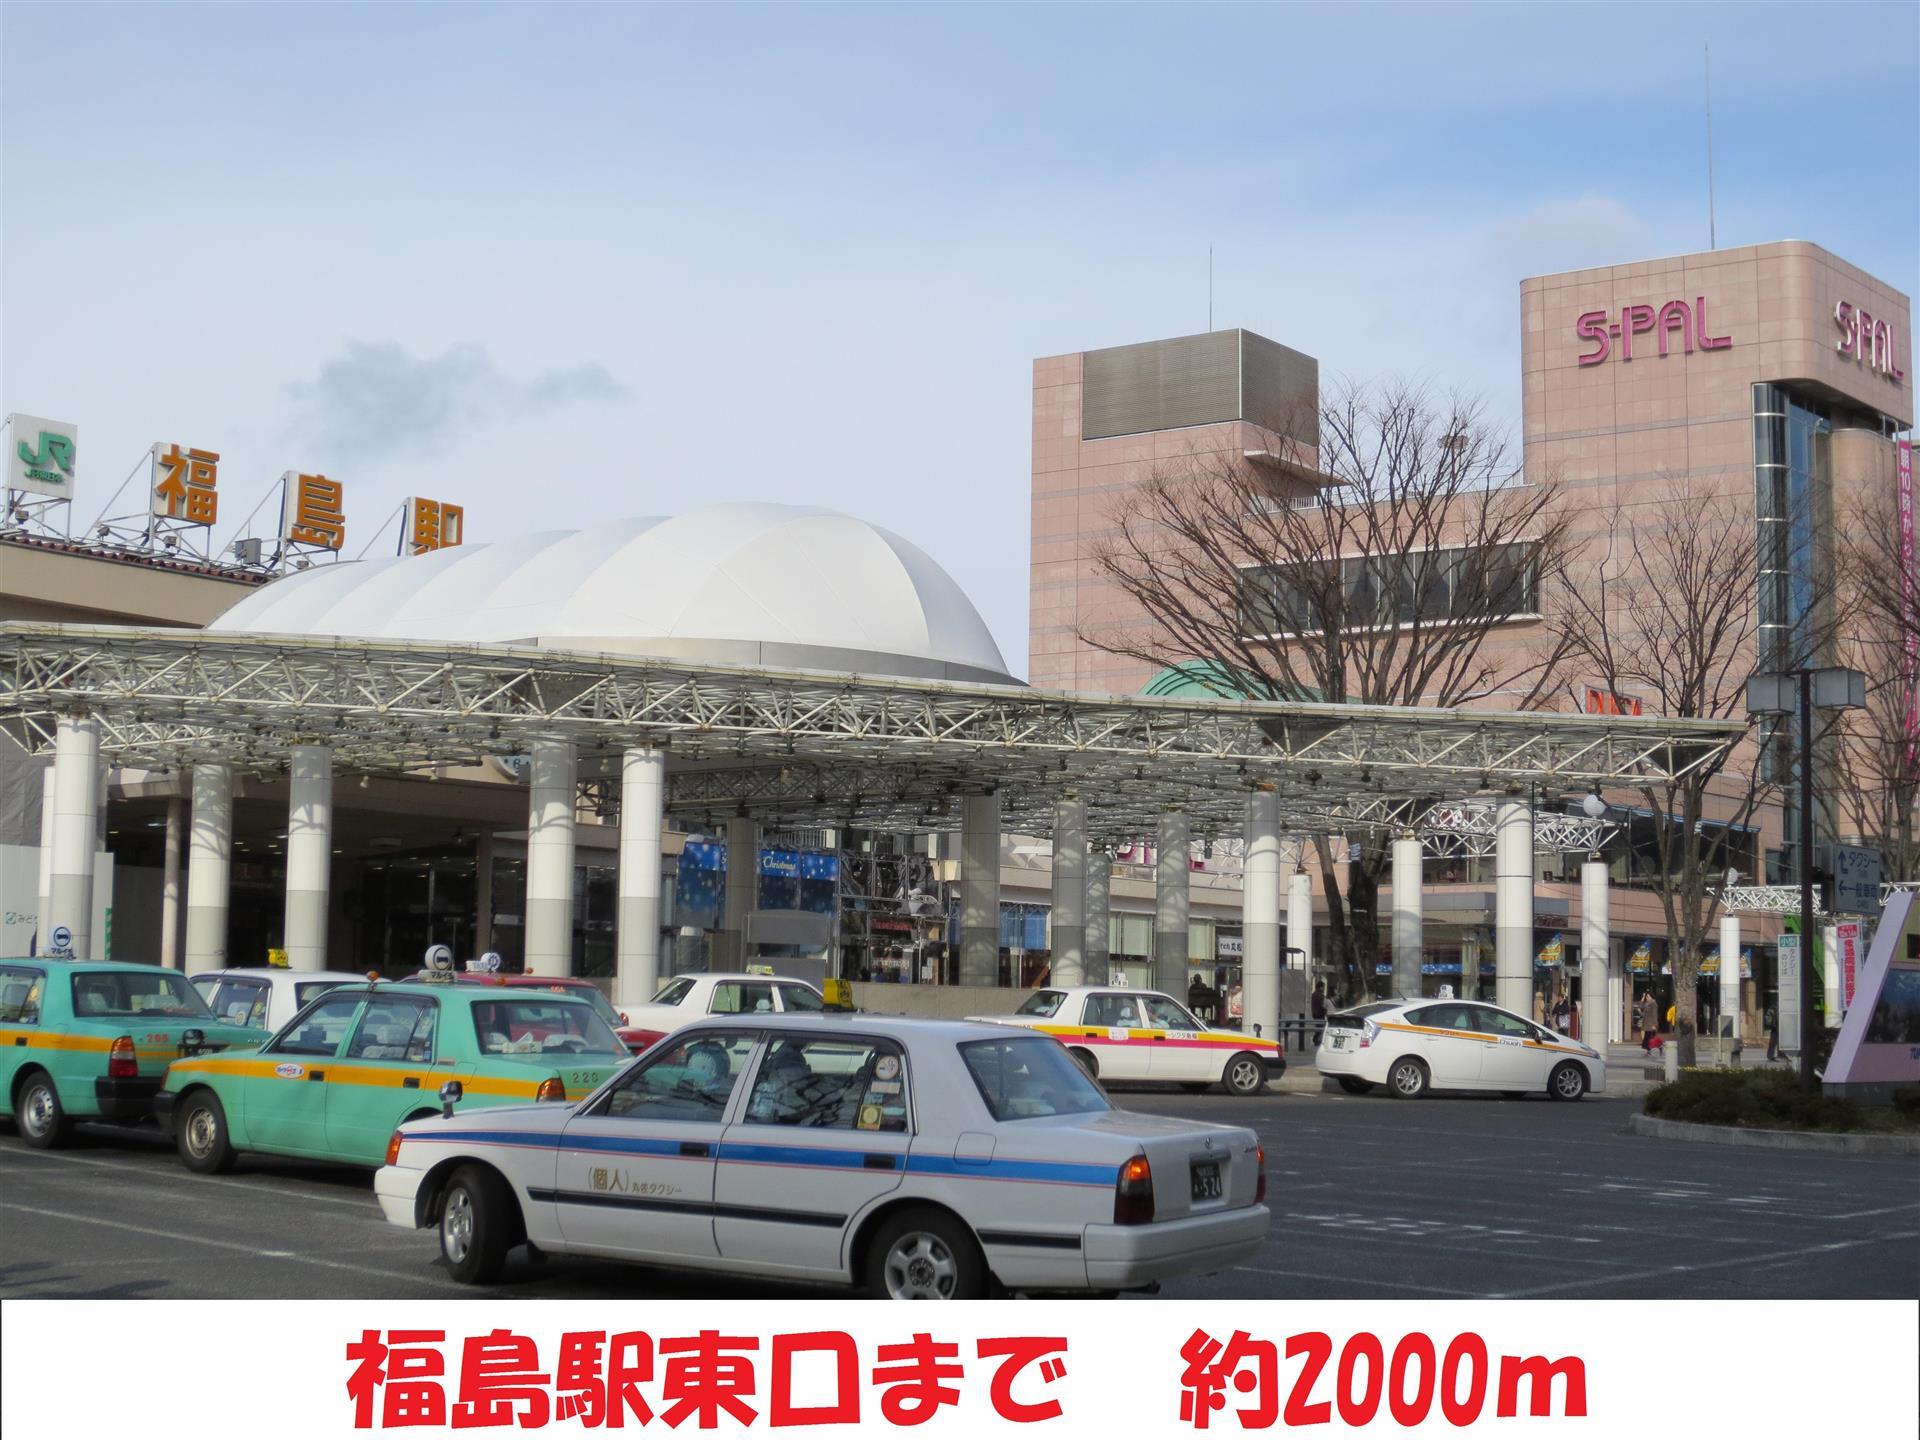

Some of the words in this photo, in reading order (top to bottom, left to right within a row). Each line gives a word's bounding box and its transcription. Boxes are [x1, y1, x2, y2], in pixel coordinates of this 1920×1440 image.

[1577, 296, 1733, 365] S-PAL
[1834, 300, 1904, 379] S-PAL
[17, 432, 72, 471] JR
[763, 856, 796, 870] Christmas
[1849, 851, 1878, 868] タクシー
